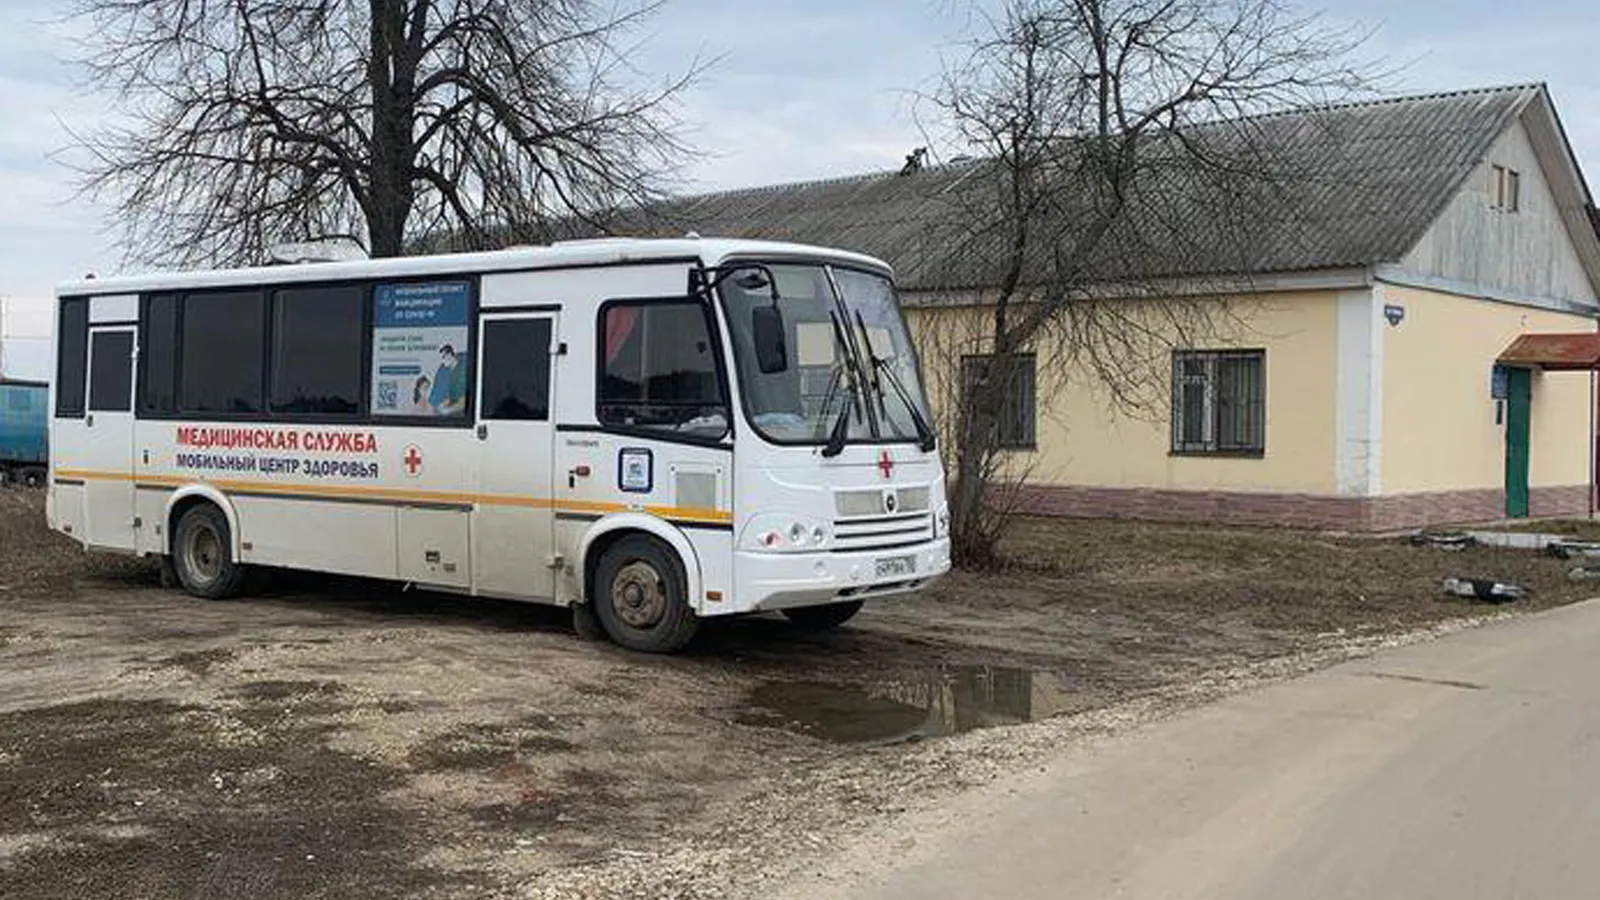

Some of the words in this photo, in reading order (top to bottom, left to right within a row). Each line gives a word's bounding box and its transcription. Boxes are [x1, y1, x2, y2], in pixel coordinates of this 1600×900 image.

[176, 427, 298, 450] МЕДИЦИНСКАЯ
[303, 431, 378, 453] СЛУЖБА
[176, 453, 257, 471] МОБИЛЬНЫЙ
[259, 457, 299, 474] ЦЕНТР
[303, 459, 379, 478] ЗДОРОВЬЯ
